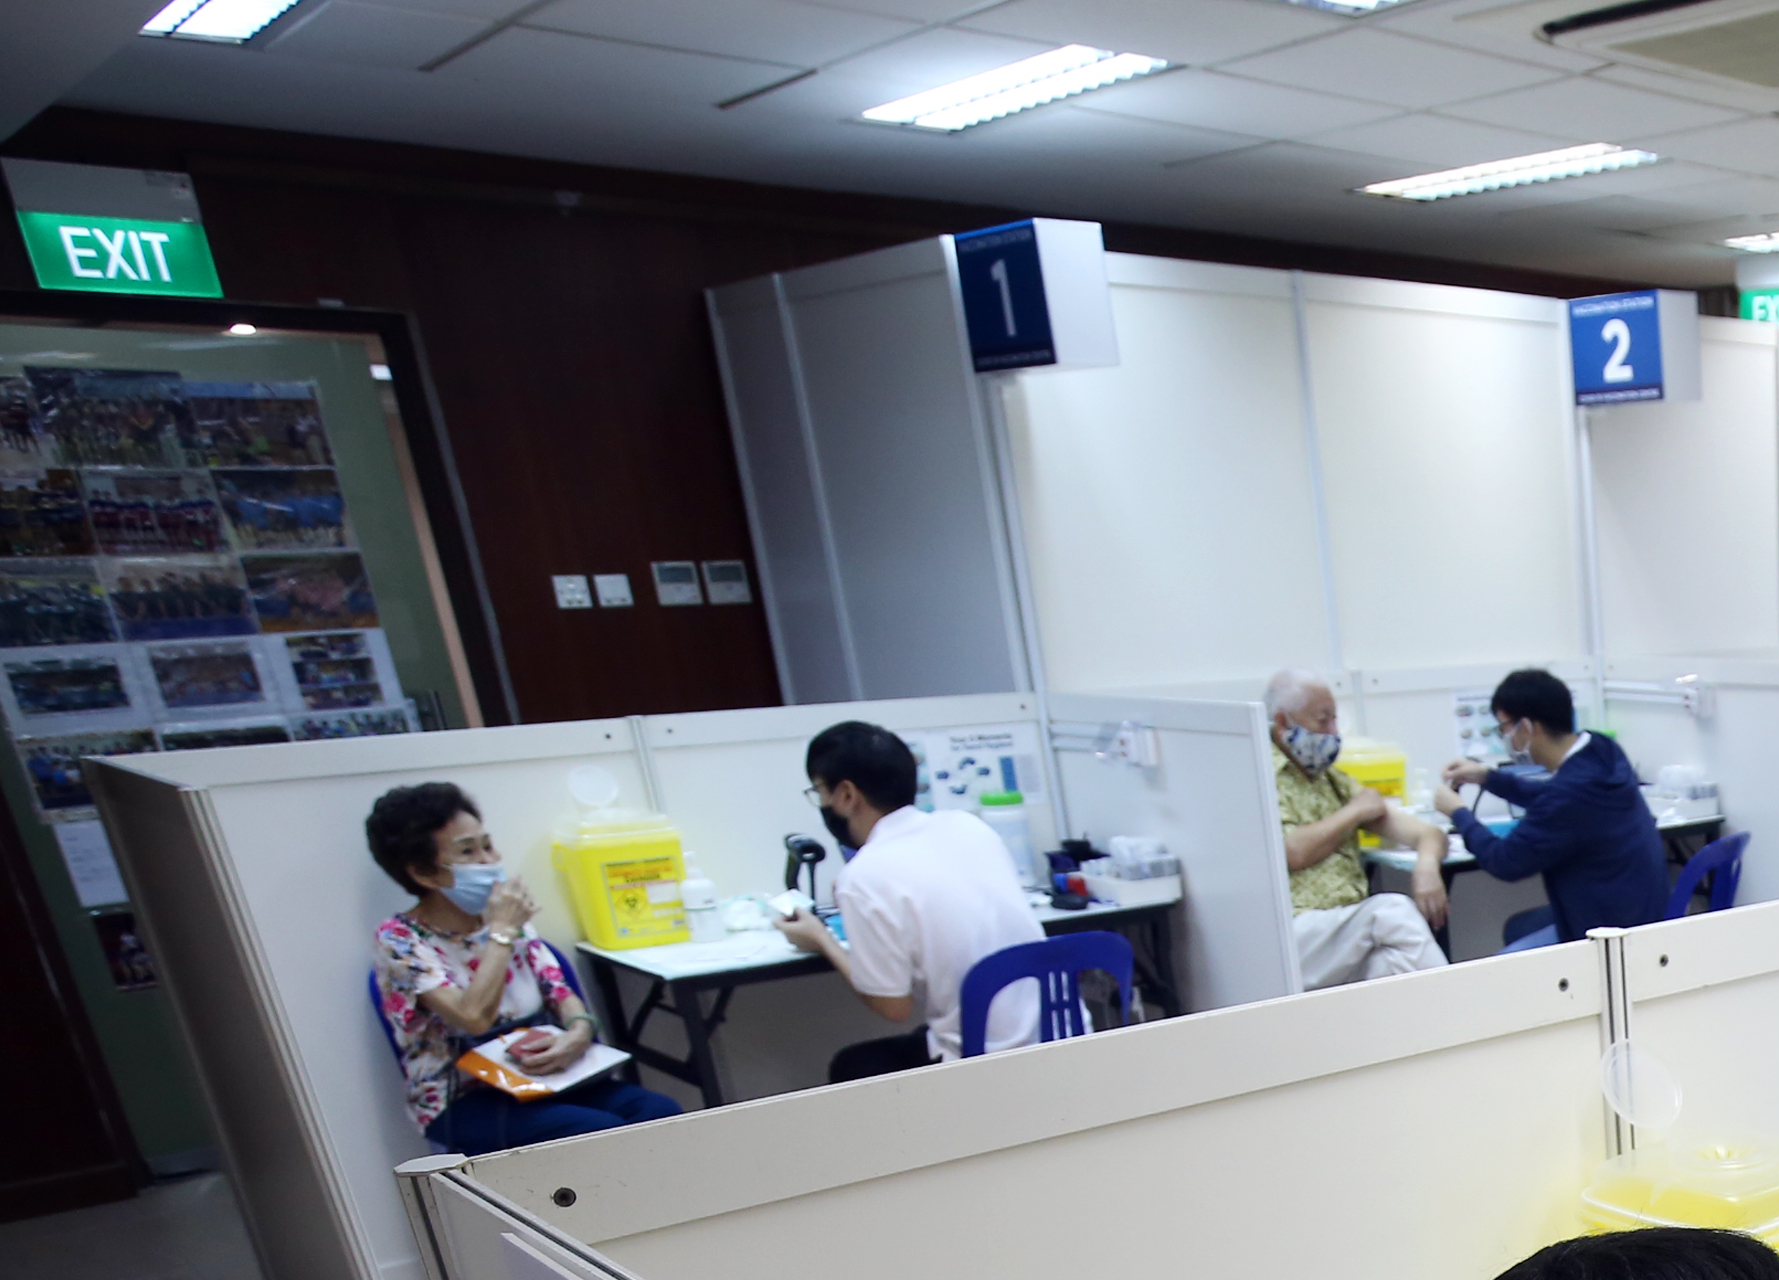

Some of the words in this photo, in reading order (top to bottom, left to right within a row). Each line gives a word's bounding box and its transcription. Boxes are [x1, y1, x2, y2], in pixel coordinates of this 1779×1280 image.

[59, 225, 172, 282] EXIT
[990, 259, 1016, 338] 1
[1601, 318, 1634, 383] 2
